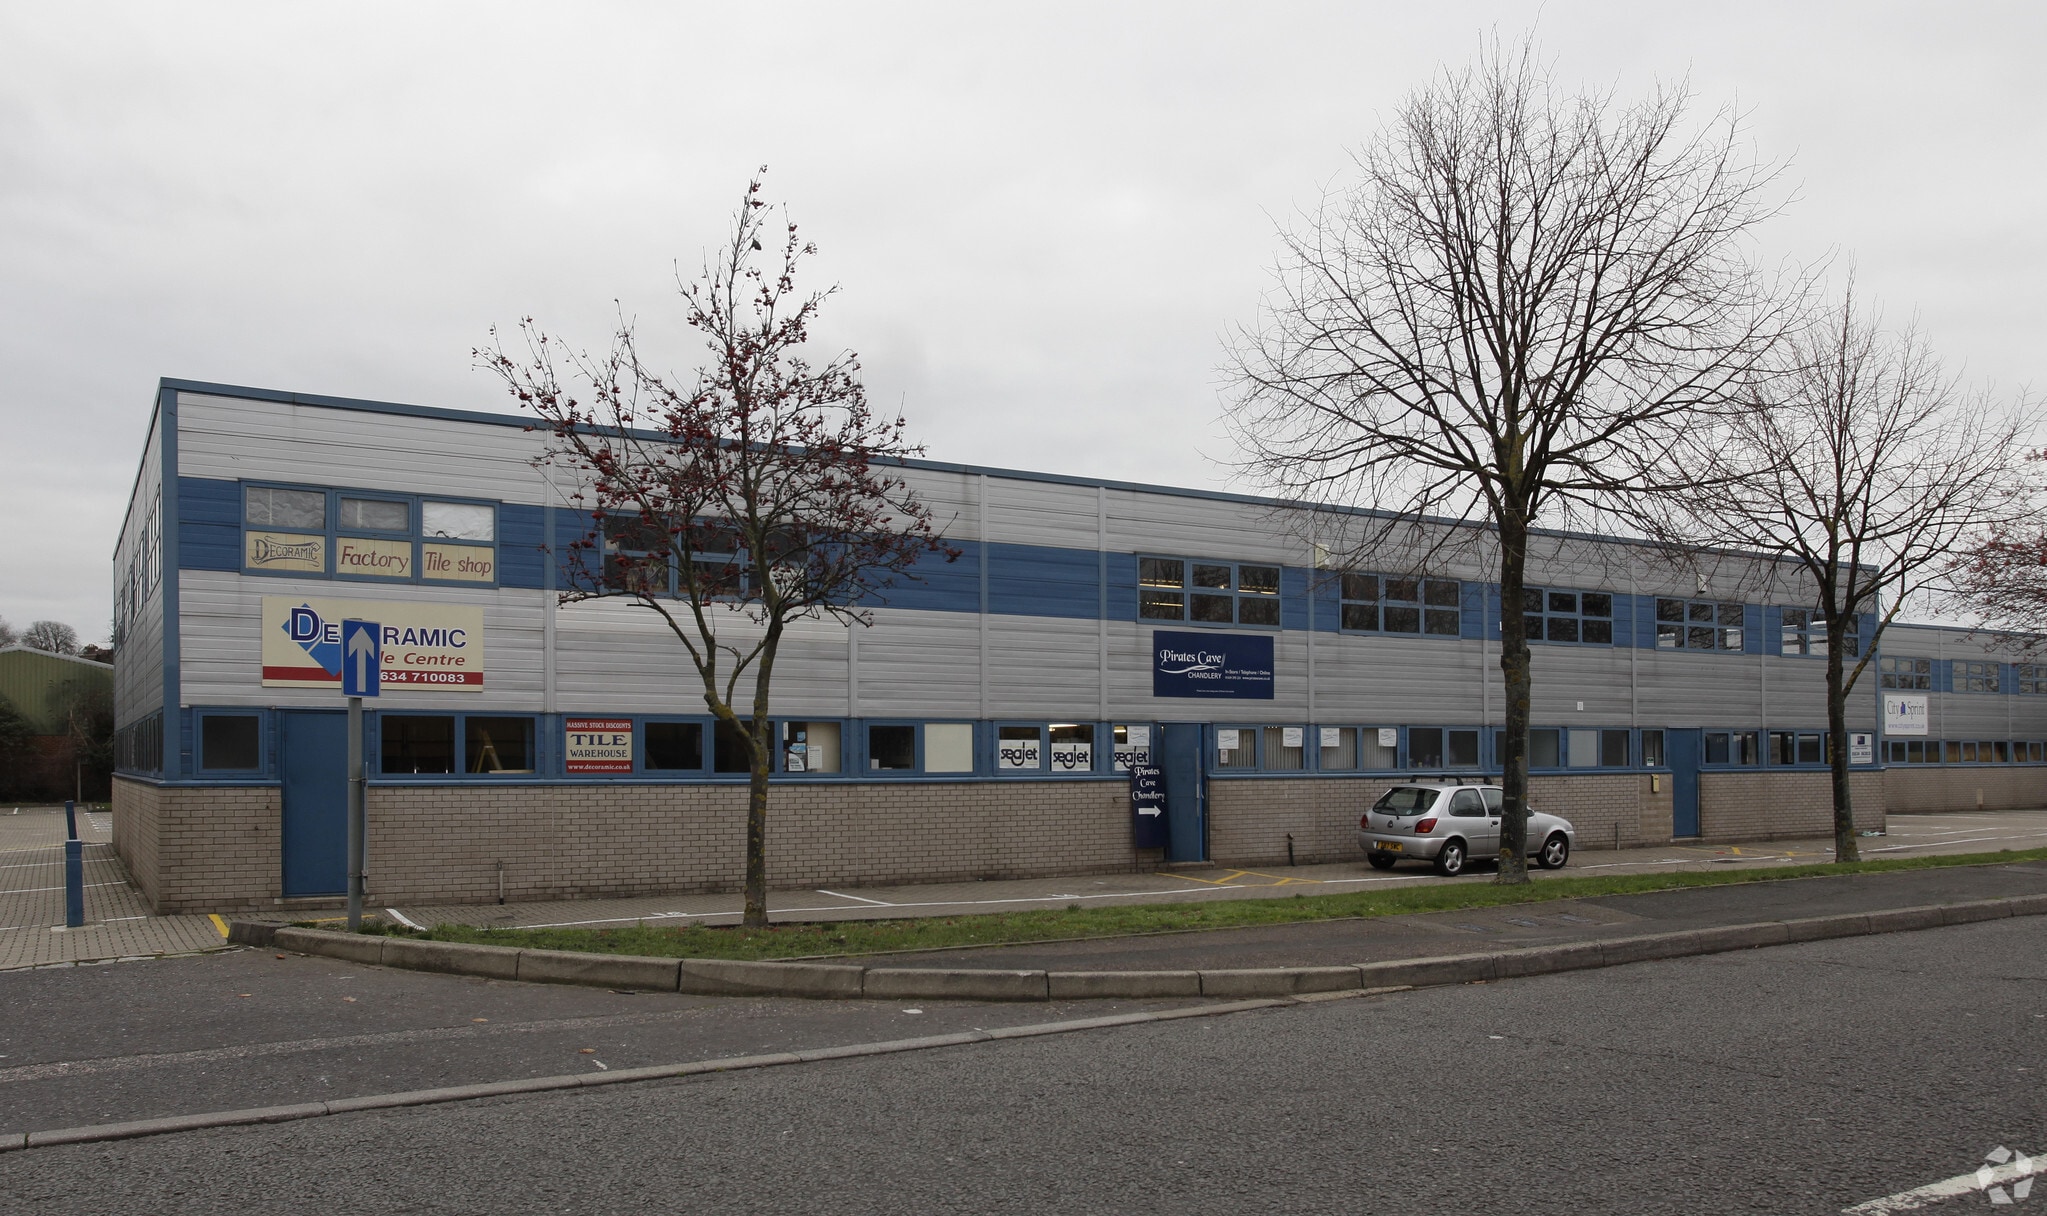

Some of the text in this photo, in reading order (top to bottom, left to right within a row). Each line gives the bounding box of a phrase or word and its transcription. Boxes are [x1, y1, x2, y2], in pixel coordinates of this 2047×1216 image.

[253, 537, 492, 577] DECORAMIC Factory Tile shop
[290, 607, 467, 649] DERAMIC
[404, 652, 465, 666] Centre
[1160, 649, 1222, 666] Pirates Cave
[412, 672, 465, 683] 710083
[1887, 701, 1925, 720] City Sprint
[570, 734, 628, 746] TILE
[570, 749, 628, 758] WAREHOUSE
[1001, 742, 1038, 767] seajet
[1053, 745, 1089, 769] seajet
[1114, 746, 1148, 769] seajet
[1134, 767, 1160, 779] Pirates
[1140, 778, 1156, 788] Cave
[1132, 790, 1165, 803] Chandlery
